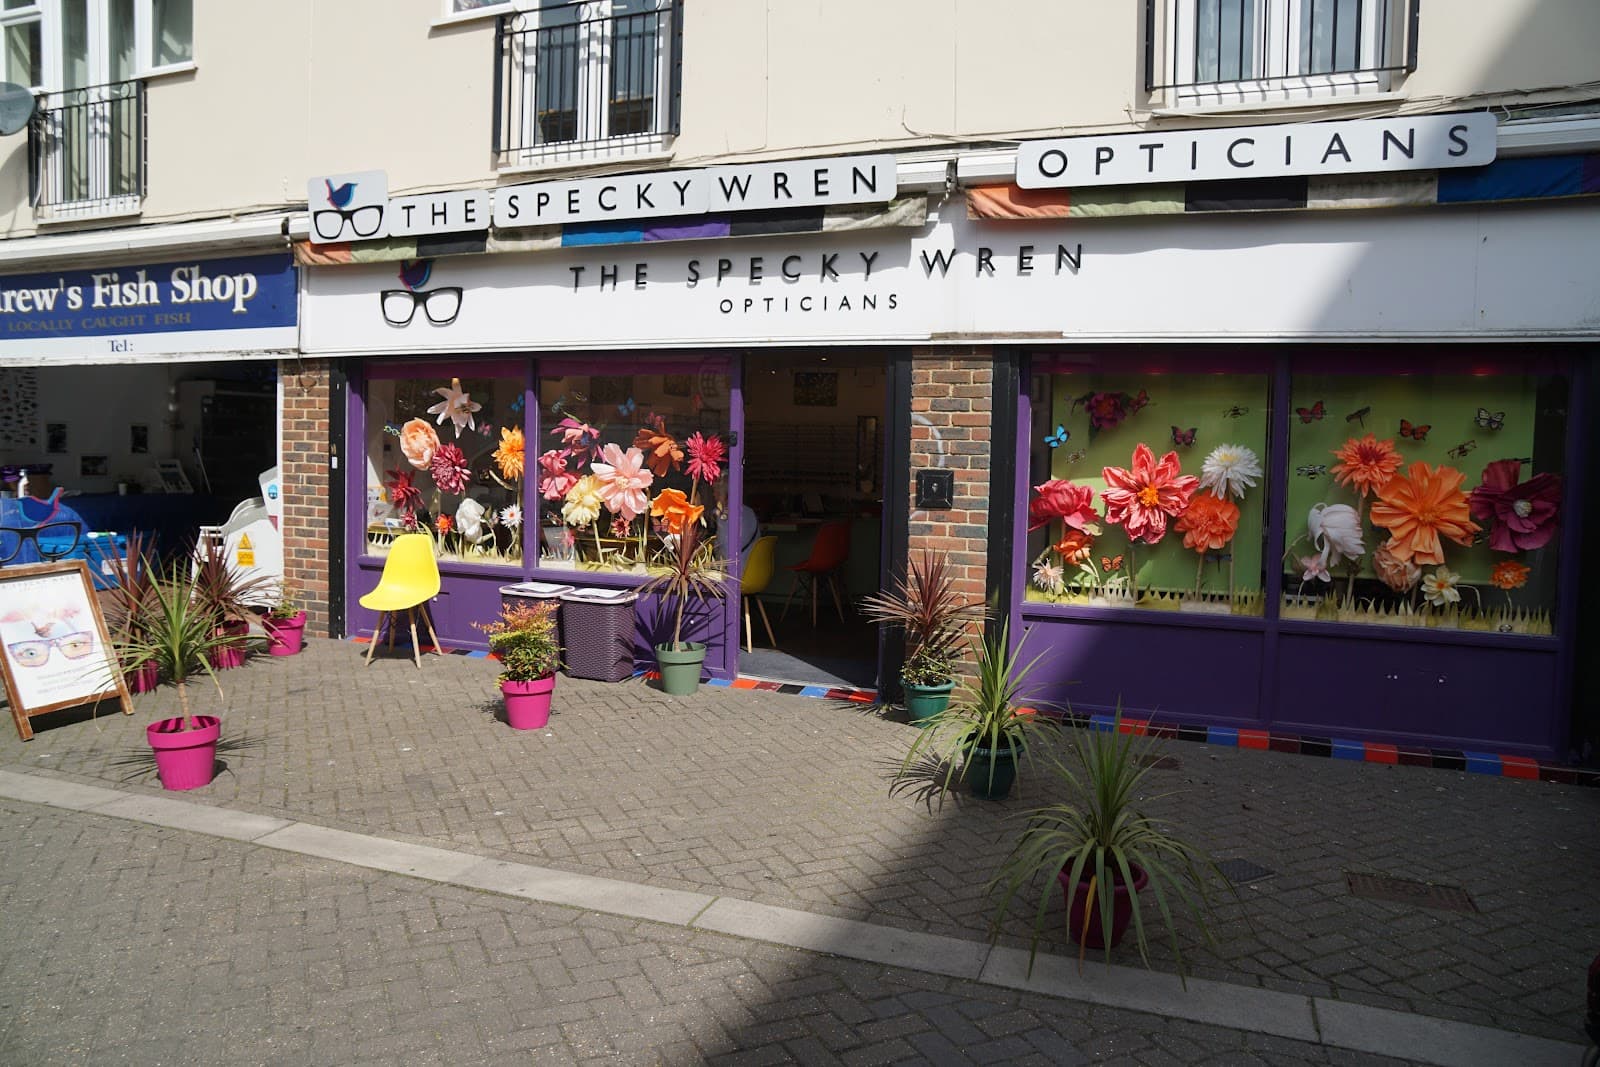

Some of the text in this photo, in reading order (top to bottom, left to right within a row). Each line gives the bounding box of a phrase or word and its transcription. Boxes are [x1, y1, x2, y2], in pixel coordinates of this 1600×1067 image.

[1038, 124, 1469, 178] OPTICIANS
[402, 165, 877, 229] THE SPECKY WREN
[569, 244, 1082, 288] THE SPECKY WREN
[0, 265, 257, 313] rew's Fish Shop
[720, 294, 898, 313] OPTICIANS
[8, 312, 191, 332] LOCALLY CAUGHT FISH
[108, 340, 134, 353] Tel:
